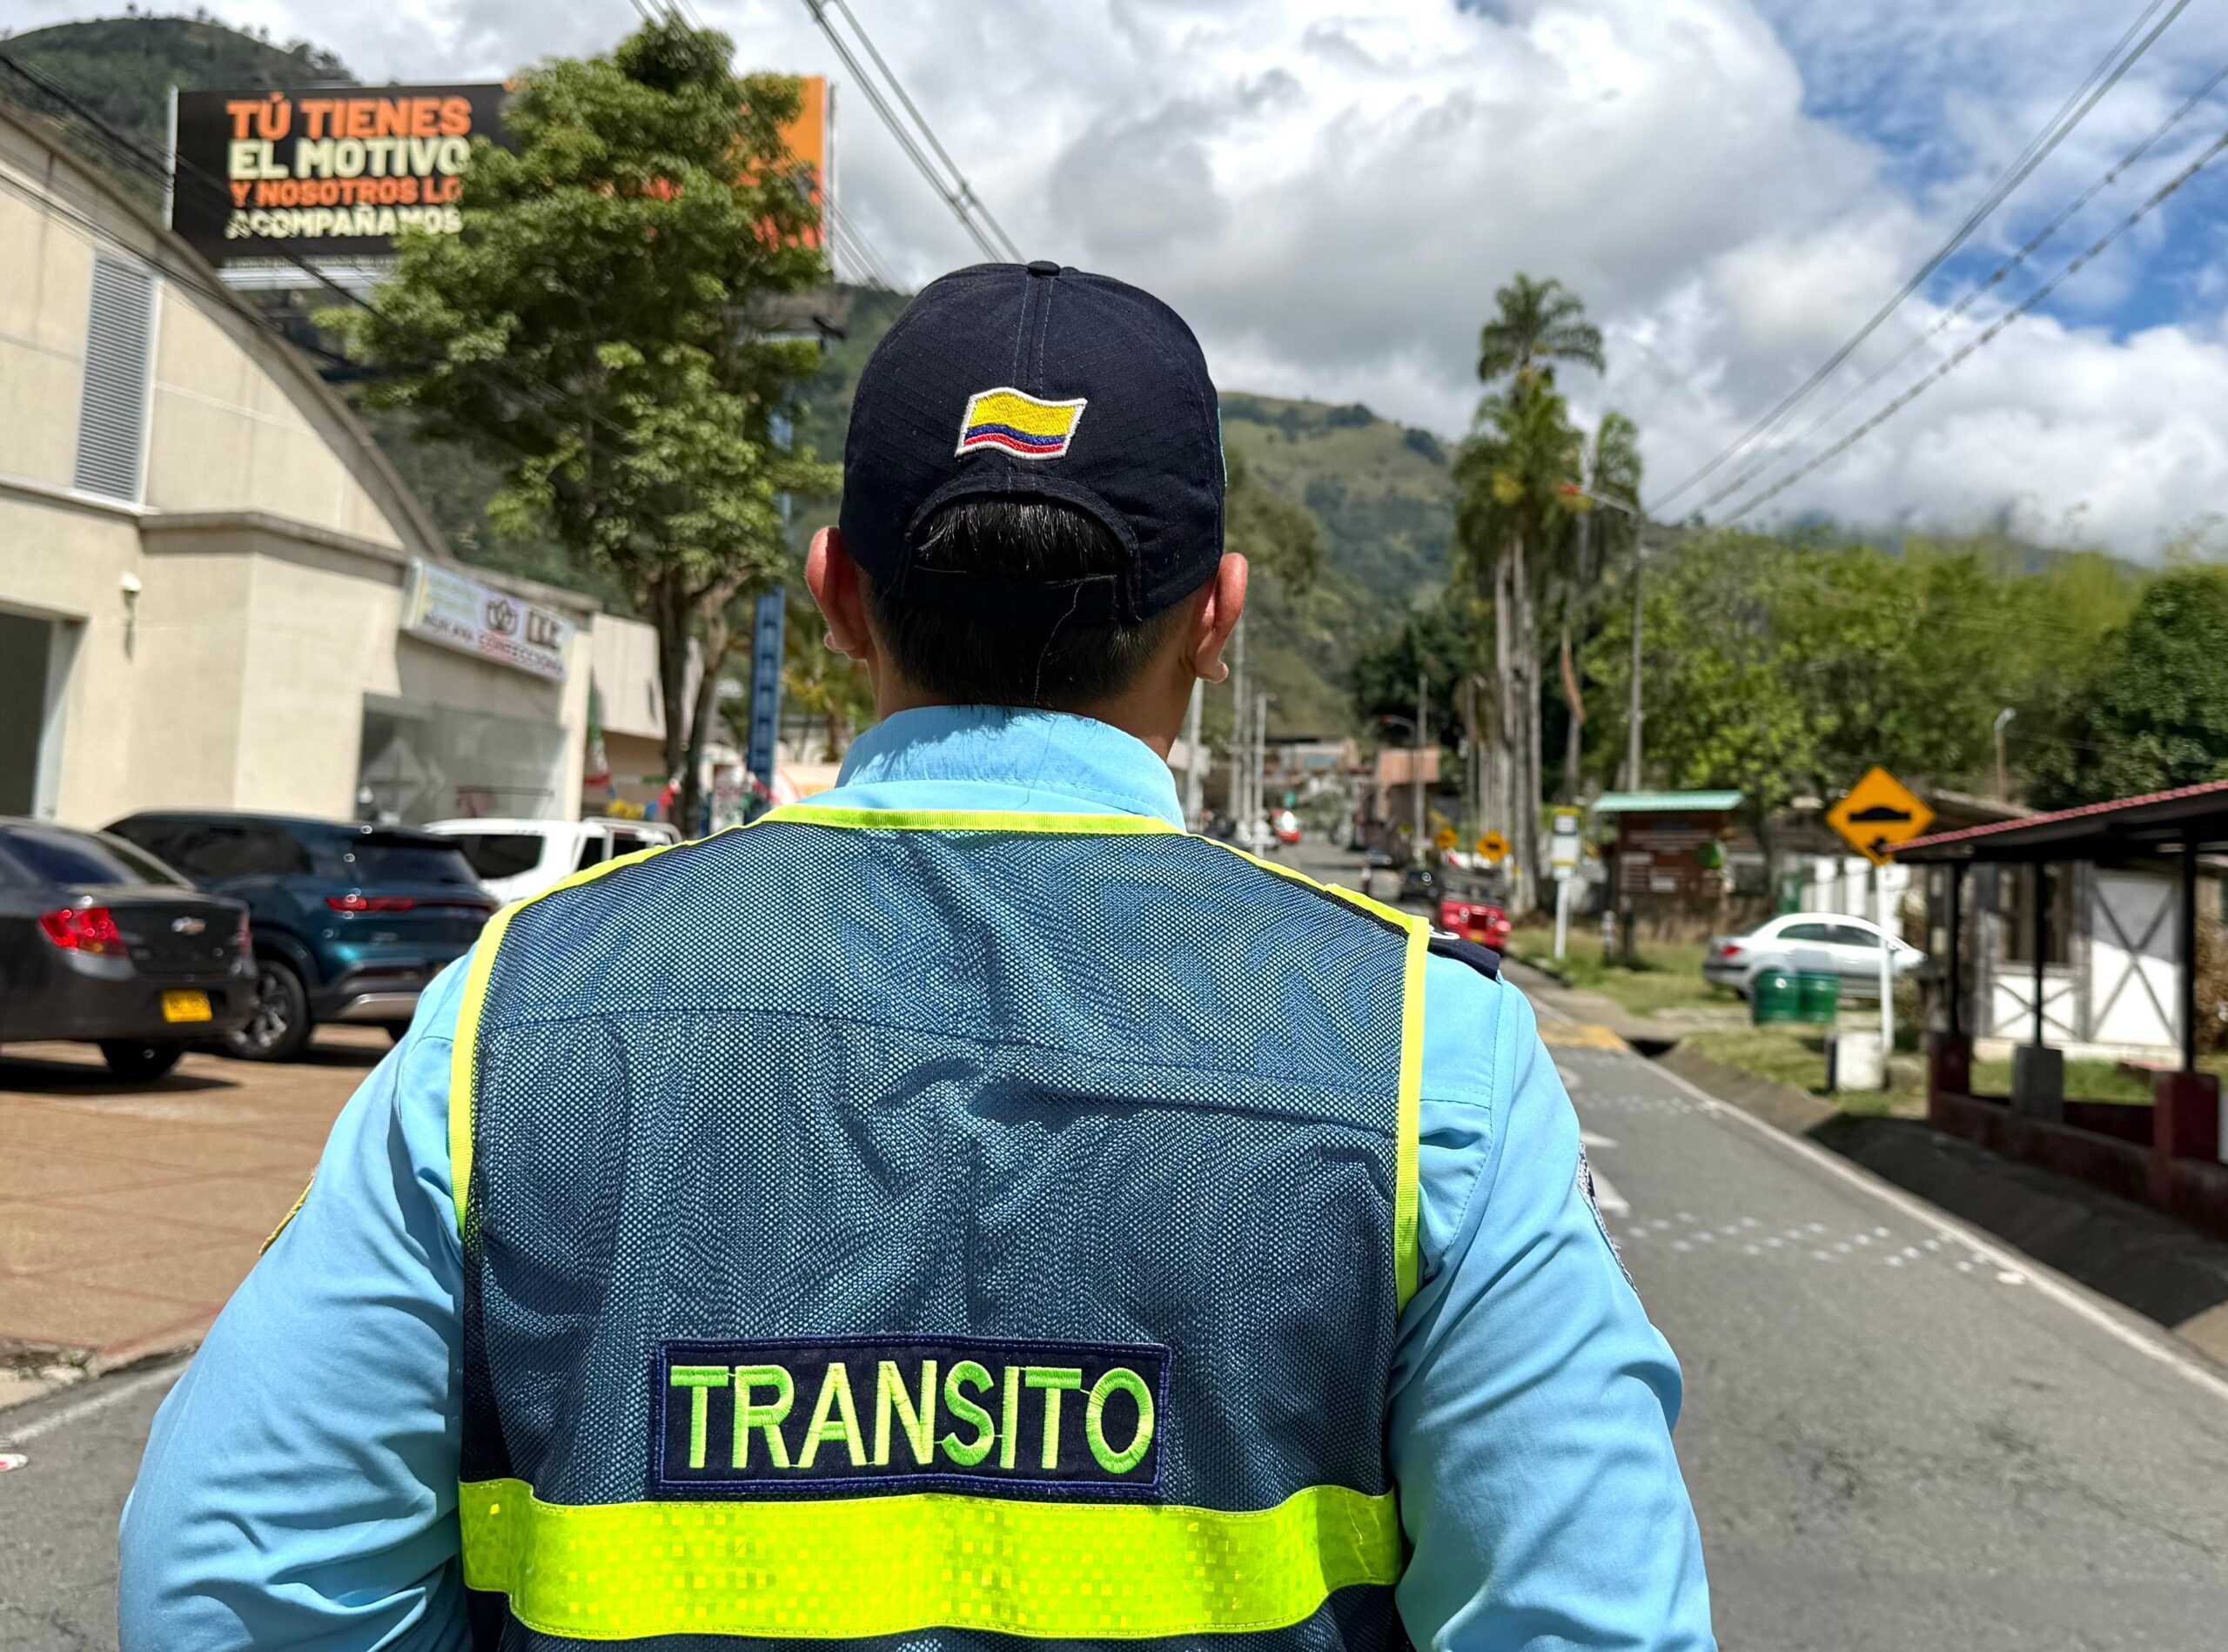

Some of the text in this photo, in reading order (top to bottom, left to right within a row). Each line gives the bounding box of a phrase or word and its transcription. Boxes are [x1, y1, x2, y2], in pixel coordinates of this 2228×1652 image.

[226, 91, 472, 139] TÚ TIENES
[229, 137, 471, 179] EL MOTIVO
[230, 176, 463, 207] Y NOSOTROS LO
[225, 202, 463, 238] ACOMPAÑAMOS
[670, 1360, 1154, 1474] TRANSITO
